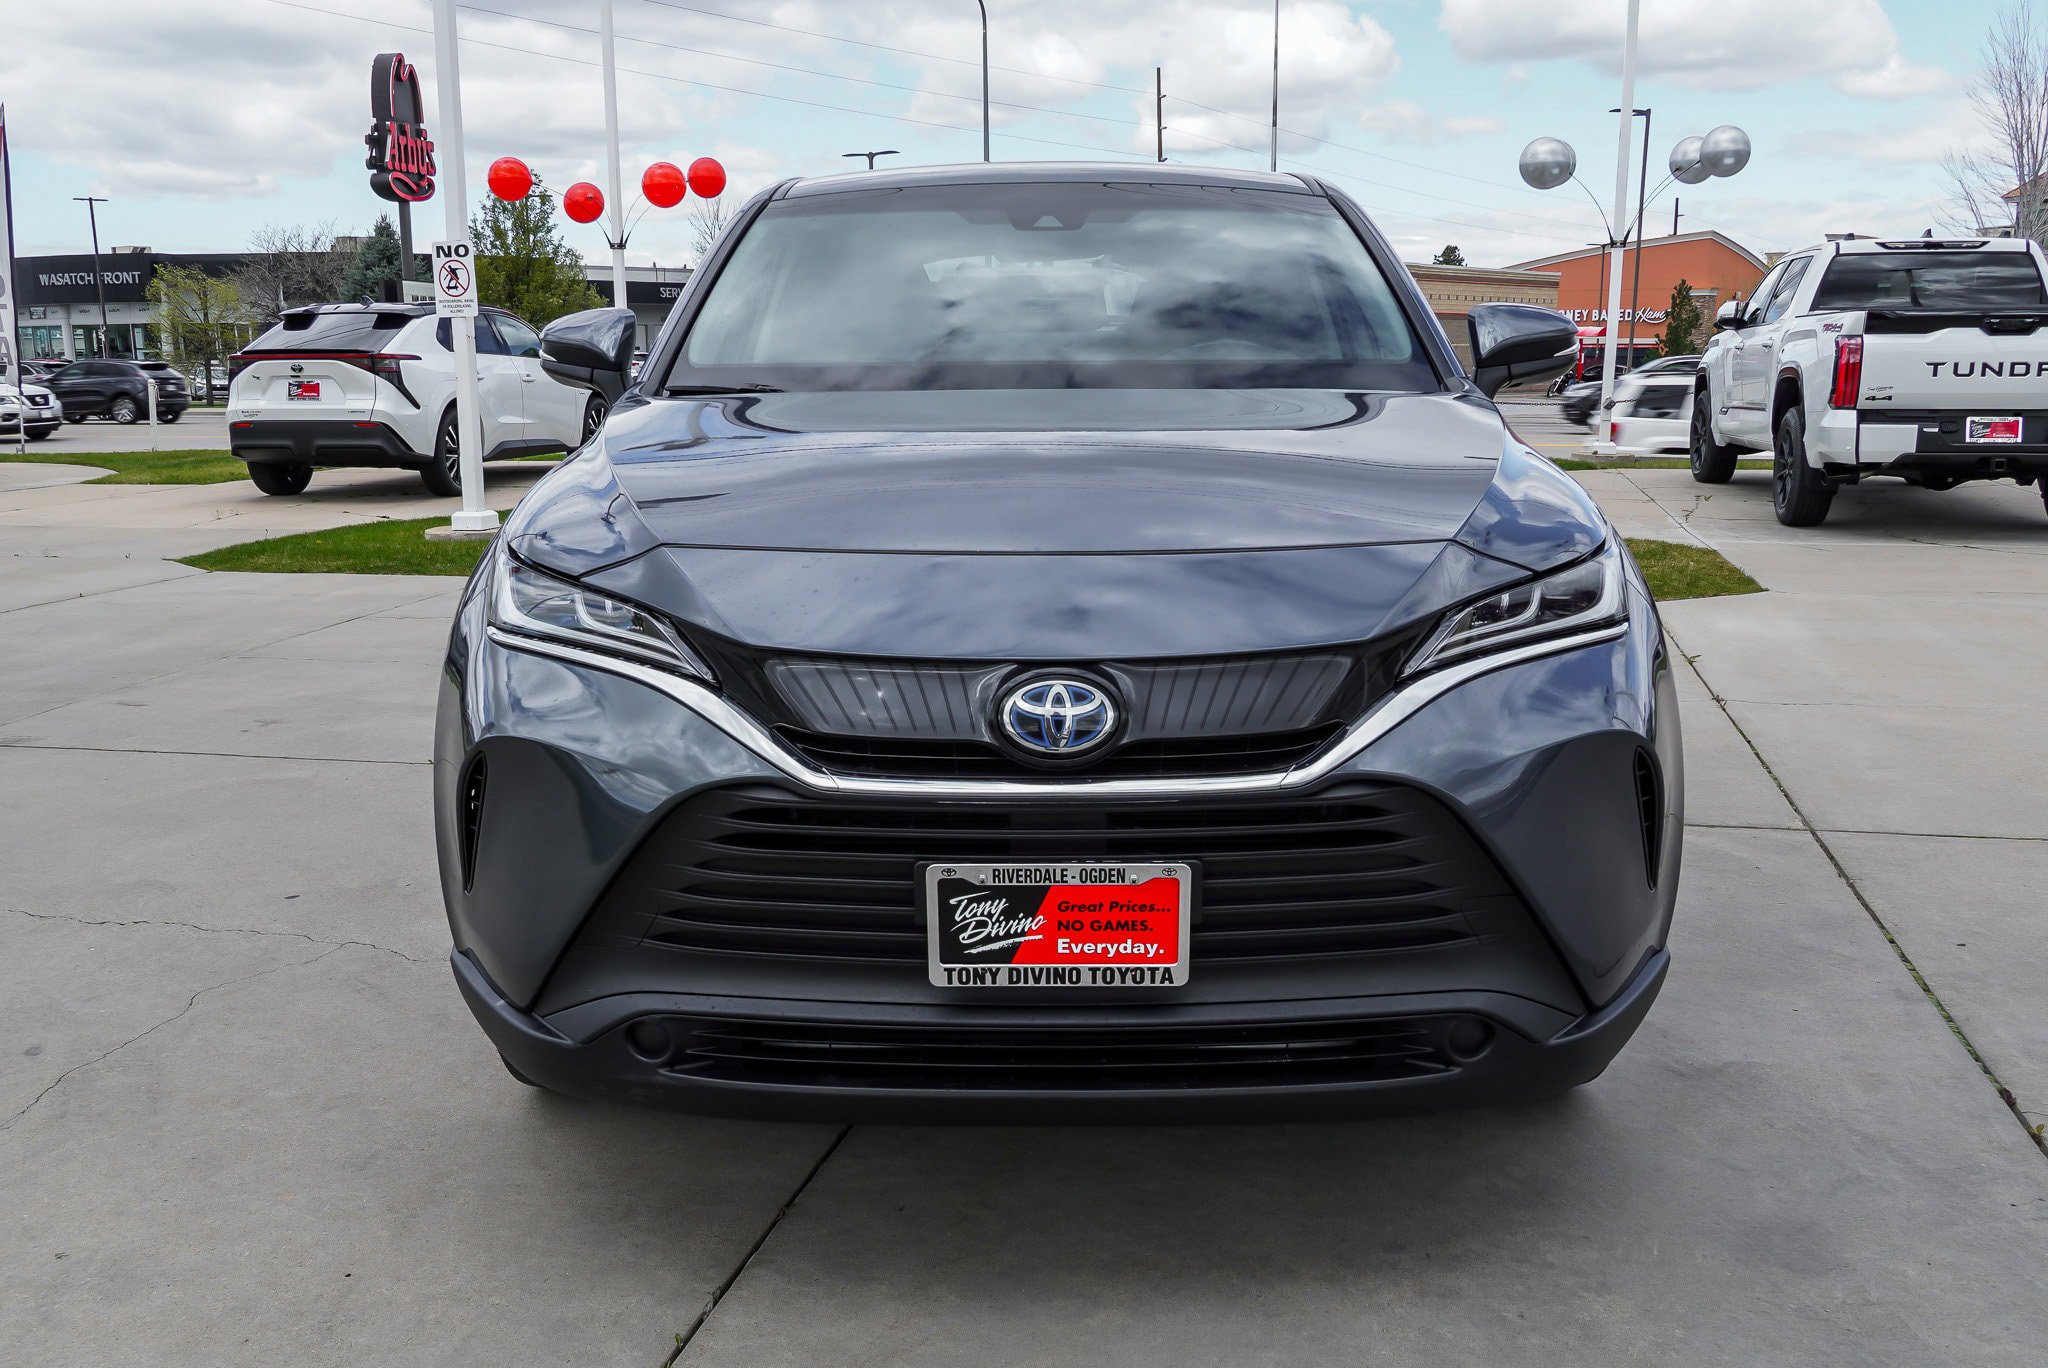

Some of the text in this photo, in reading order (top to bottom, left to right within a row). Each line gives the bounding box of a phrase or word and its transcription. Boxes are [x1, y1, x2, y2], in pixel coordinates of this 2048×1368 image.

[436, 244, 470, 259] NO
[39, 272, 94, 286] WASATCH
[1591, 309, 1633, 321] BAED
[1634, 306, 1667, 324] Ham
[992, 867, 1068, 885] RIVERDALE
[1079, 867, 1126, 885] OGDEN
[949, 891, 1010, 923] Tony
[1057, 900, 1172, 913] Great Prices...
[950, 912, 1047, 944] Divino
[1057, 919, 1154, 932] NO GAMES.
[1057, 938, 1165, 958] Everyday.
[943, 966, 1175, 986] TONY DIVINO TOYOTA
